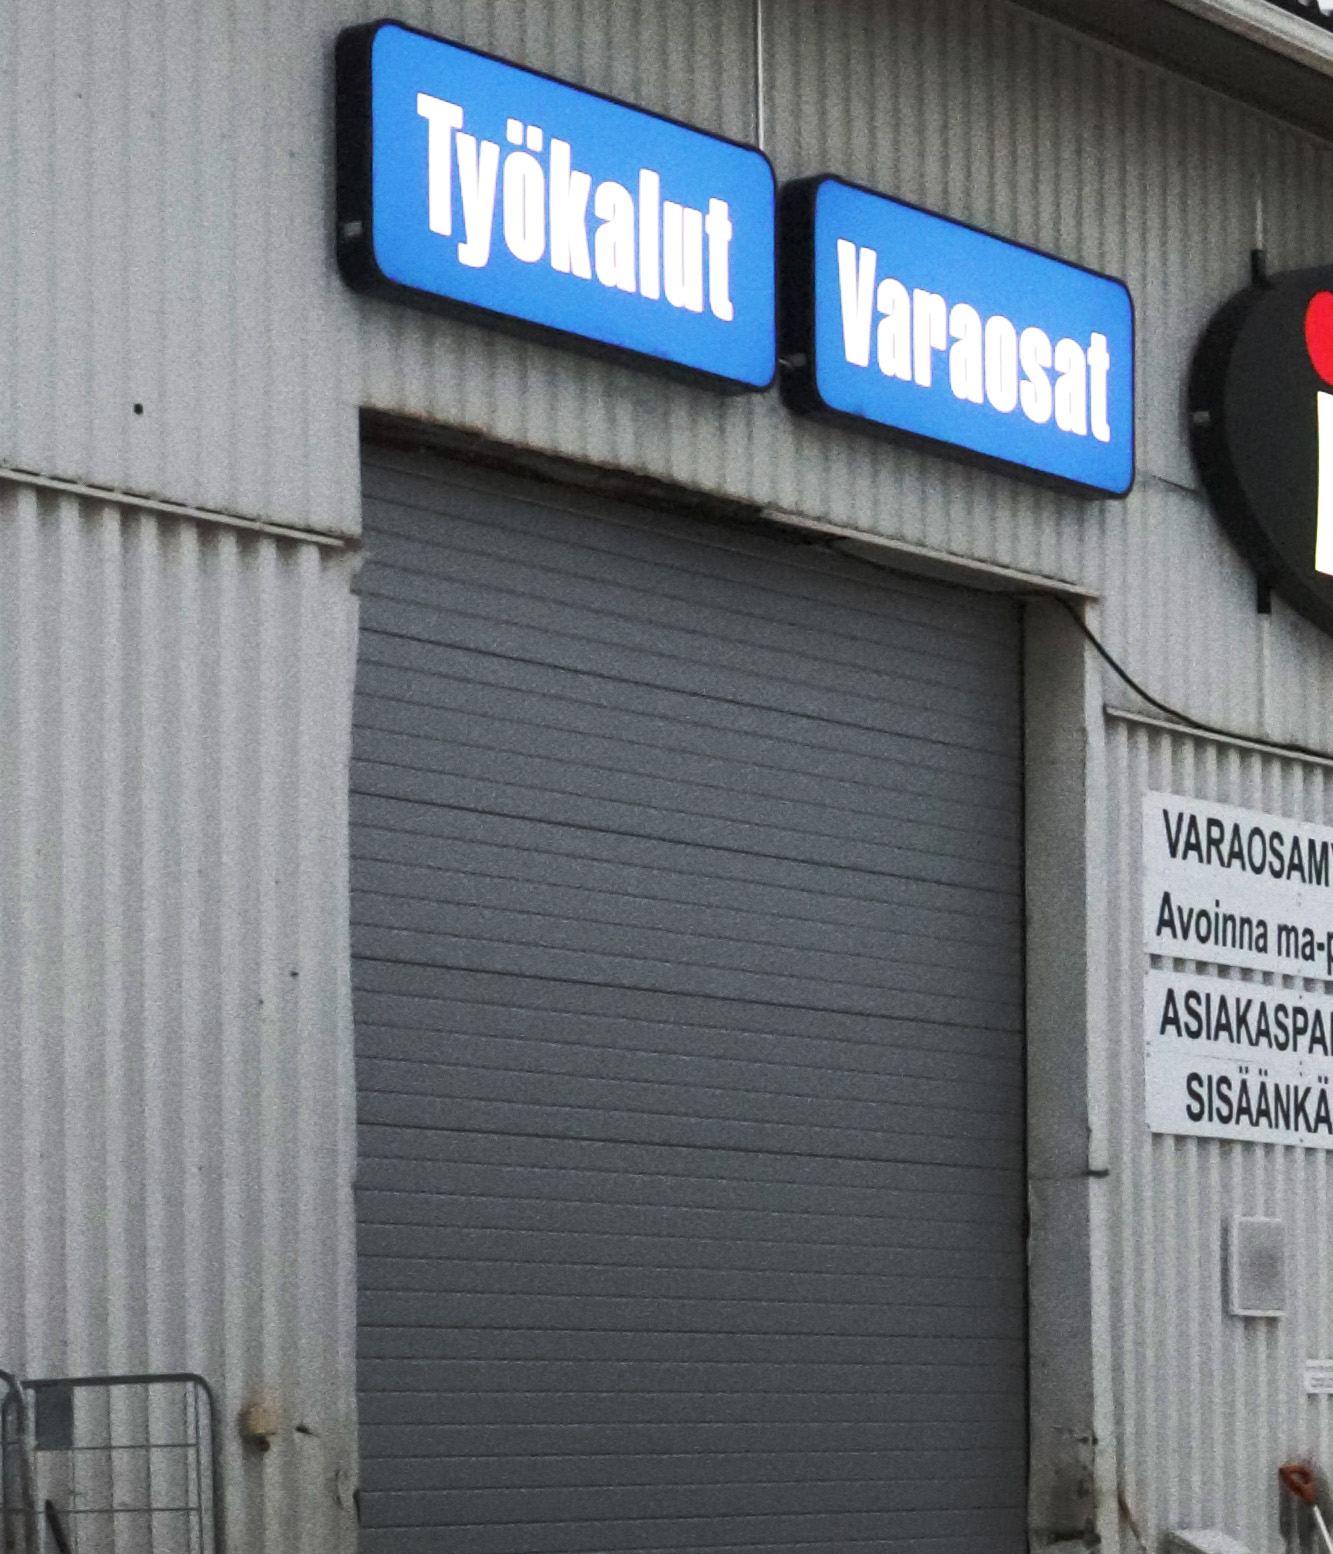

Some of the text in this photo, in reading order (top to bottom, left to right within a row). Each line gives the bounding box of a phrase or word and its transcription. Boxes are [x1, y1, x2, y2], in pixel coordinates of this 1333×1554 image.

[416, 92, 734, 322] Työkalut
[836, 238, 1112, 443] Varaosat
[1155, 891, 1269, 955] Avoinna
